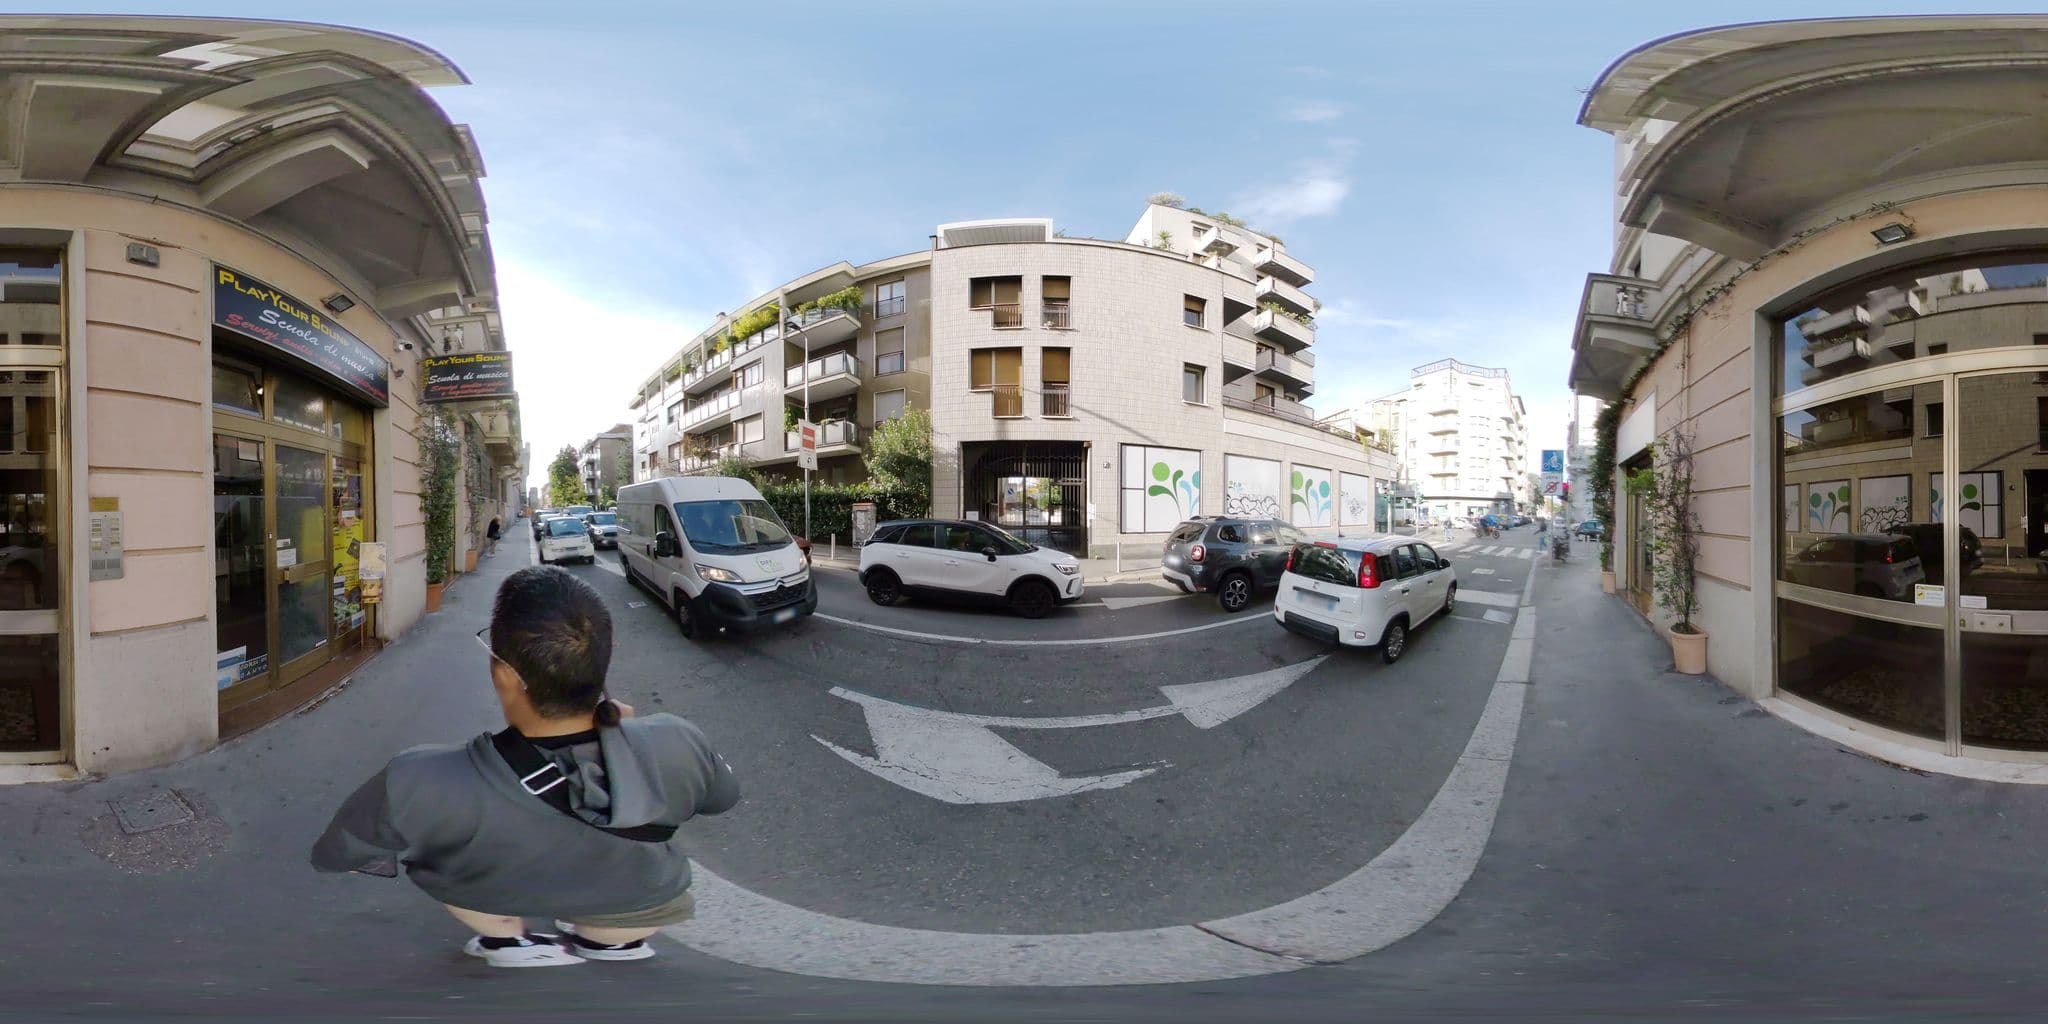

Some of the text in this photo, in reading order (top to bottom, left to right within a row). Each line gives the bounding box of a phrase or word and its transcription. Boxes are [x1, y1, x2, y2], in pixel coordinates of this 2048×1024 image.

[259, 309, 319, 346] Scuola
[324, 343, 338, 357] di
[428, 371, 509, 384] Scuola di musica
